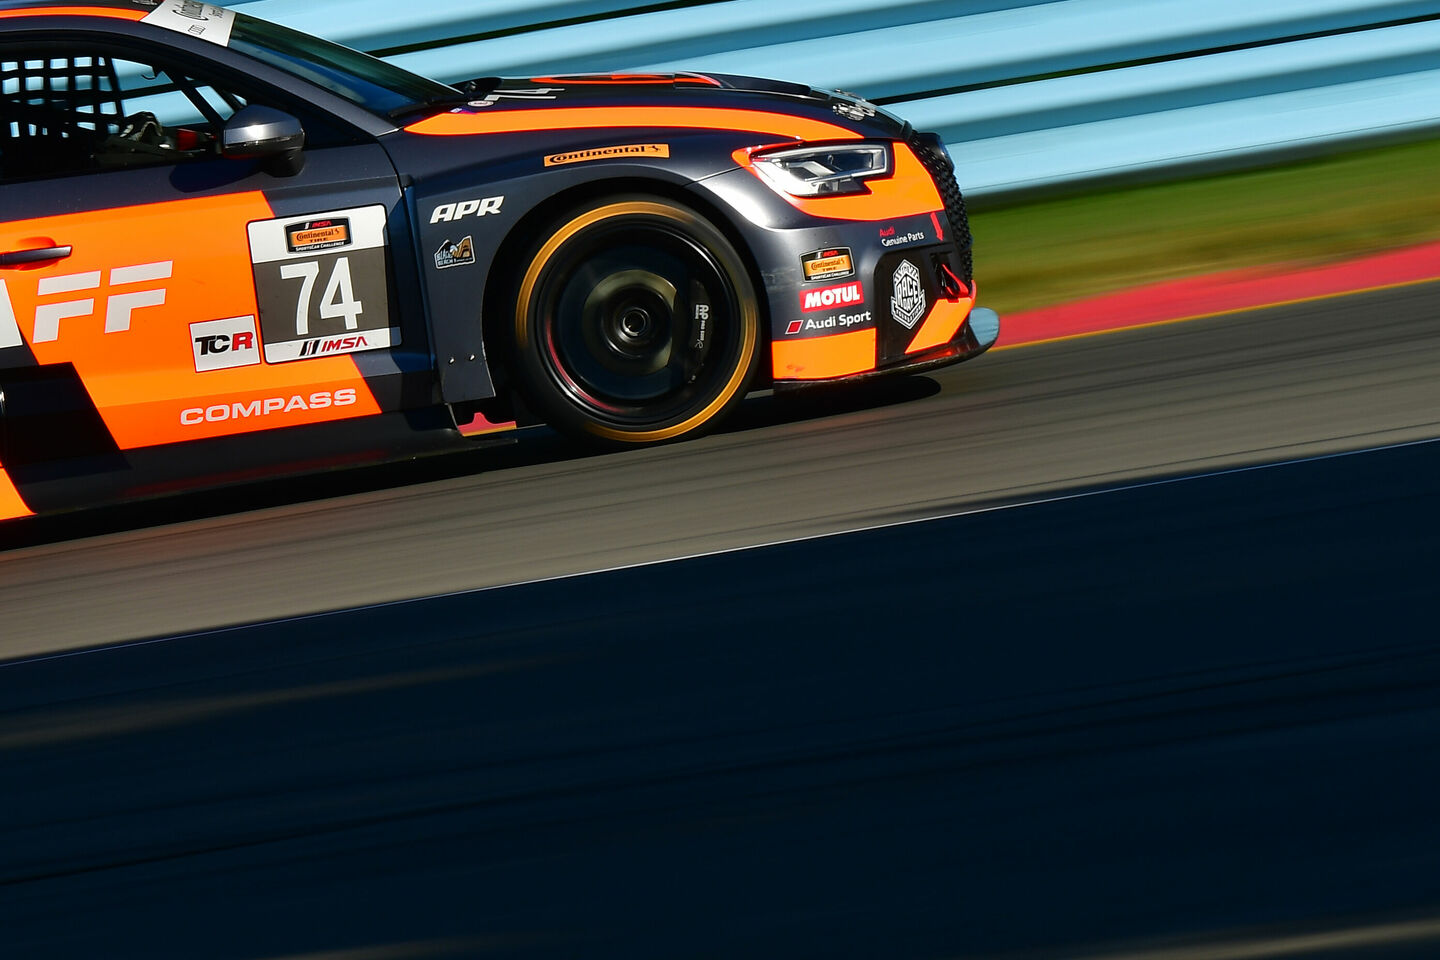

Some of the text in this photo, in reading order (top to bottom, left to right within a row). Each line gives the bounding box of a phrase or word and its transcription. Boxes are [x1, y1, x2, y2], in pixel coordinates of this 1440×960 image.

[549, 146, 646, 163] Continental
[429, 195, 505, 224] APR
[296, 228, 334, 241] Continental
[881, 232, 925, 247] Genuine Parts
[280, 257, 363, 336] 74
[804, 285, 861, 309] MOTUL
[805, 311, 871, 330] Audi Sport
[194, 331, 254, 356] TCR
[321, 336, 368, 353] IMSA
[180, 388, 357, 425] COMPASS
